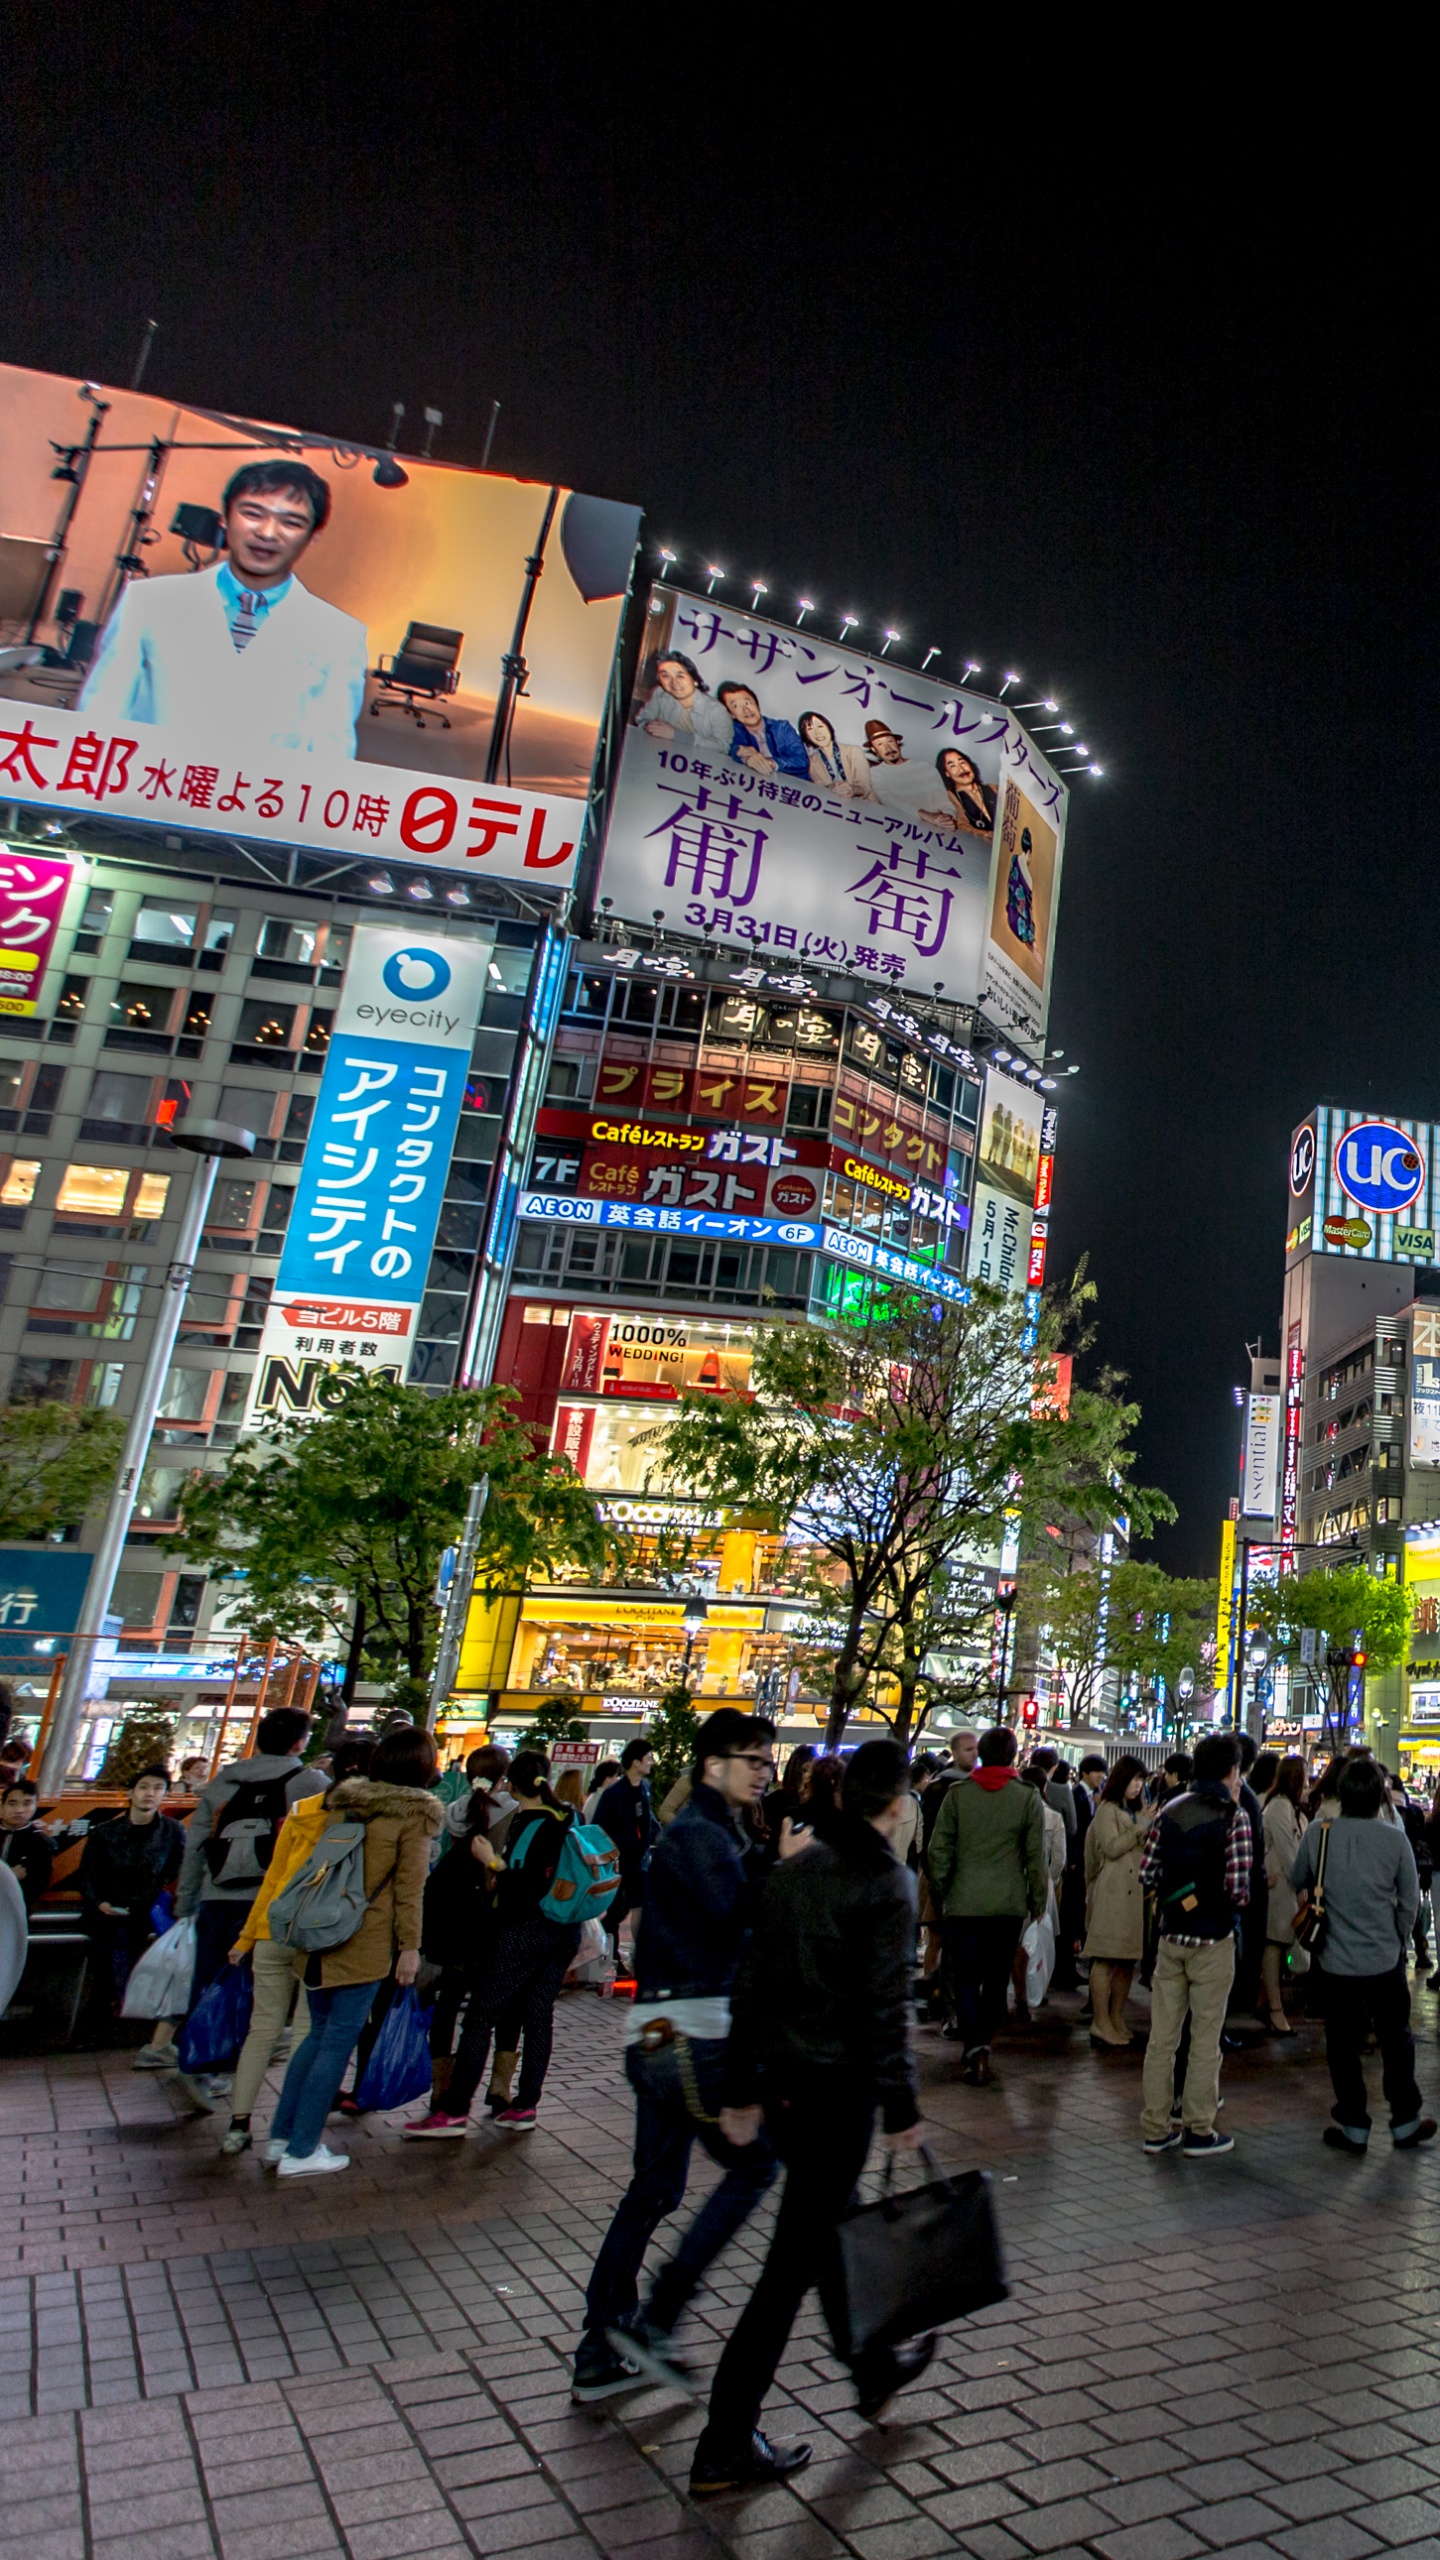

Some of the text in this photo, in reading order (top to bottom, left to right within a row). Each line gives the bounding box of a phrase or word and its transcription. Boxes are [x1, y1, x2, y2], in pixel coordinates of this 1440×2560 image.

[678, 608, 1062, 824] サザンオールスターズ
[0, 719, 139, 801] 太郎
[658, 750, 965, 856] 10年ぶり待望のニューアルバム
[356, 1002, 461, 1036] eyecity
[602, 1065, 779, 1114] プライス
[708, 1130, 798, 1167] ガスト
[834, 1096, 944, 1171] コンタクト
[307, 1057, 399, 1275] アイシティ
[371, 1065, 449, 1280] コンタクトの
[535, 1156, 580, 1183] 7F
[589, 1162, 640, 1185] Café
[588, 1181, 638, 1197] レストラン
[642, 1164, 756, 1210] ガスト
[776, 1191, 812, 1205] ガスト
[527, 1197, 593, 1220] AEON
[910, 1184, 962, 1226] ガスト
[607, 1204, 808, 1241] 英会話イーオン 6F
[1324, 1224, 1371, 1240] MasterCard
[829, 1231, 869, 1263] AEON
[998, 1206, 1020, 1298] Mr.Childre
[1398, 1234, 1434, 1251] VISA
[1029, 1248, 1043, 1279] ガスト
[297, 1301, 403, 1333] 当ビル5階
[295, 1336, 379, 1357] 利用者数
[611, 1324, 687, 1348] 1000%
[1413, 1402, 1440, 1416] 夜11
[564, 1411, 585, 1473] 常設販売
[616, 1606, 677, 1616] L'OCCITANE
[602, 1697, 659, 1708] L'OCCITANE
